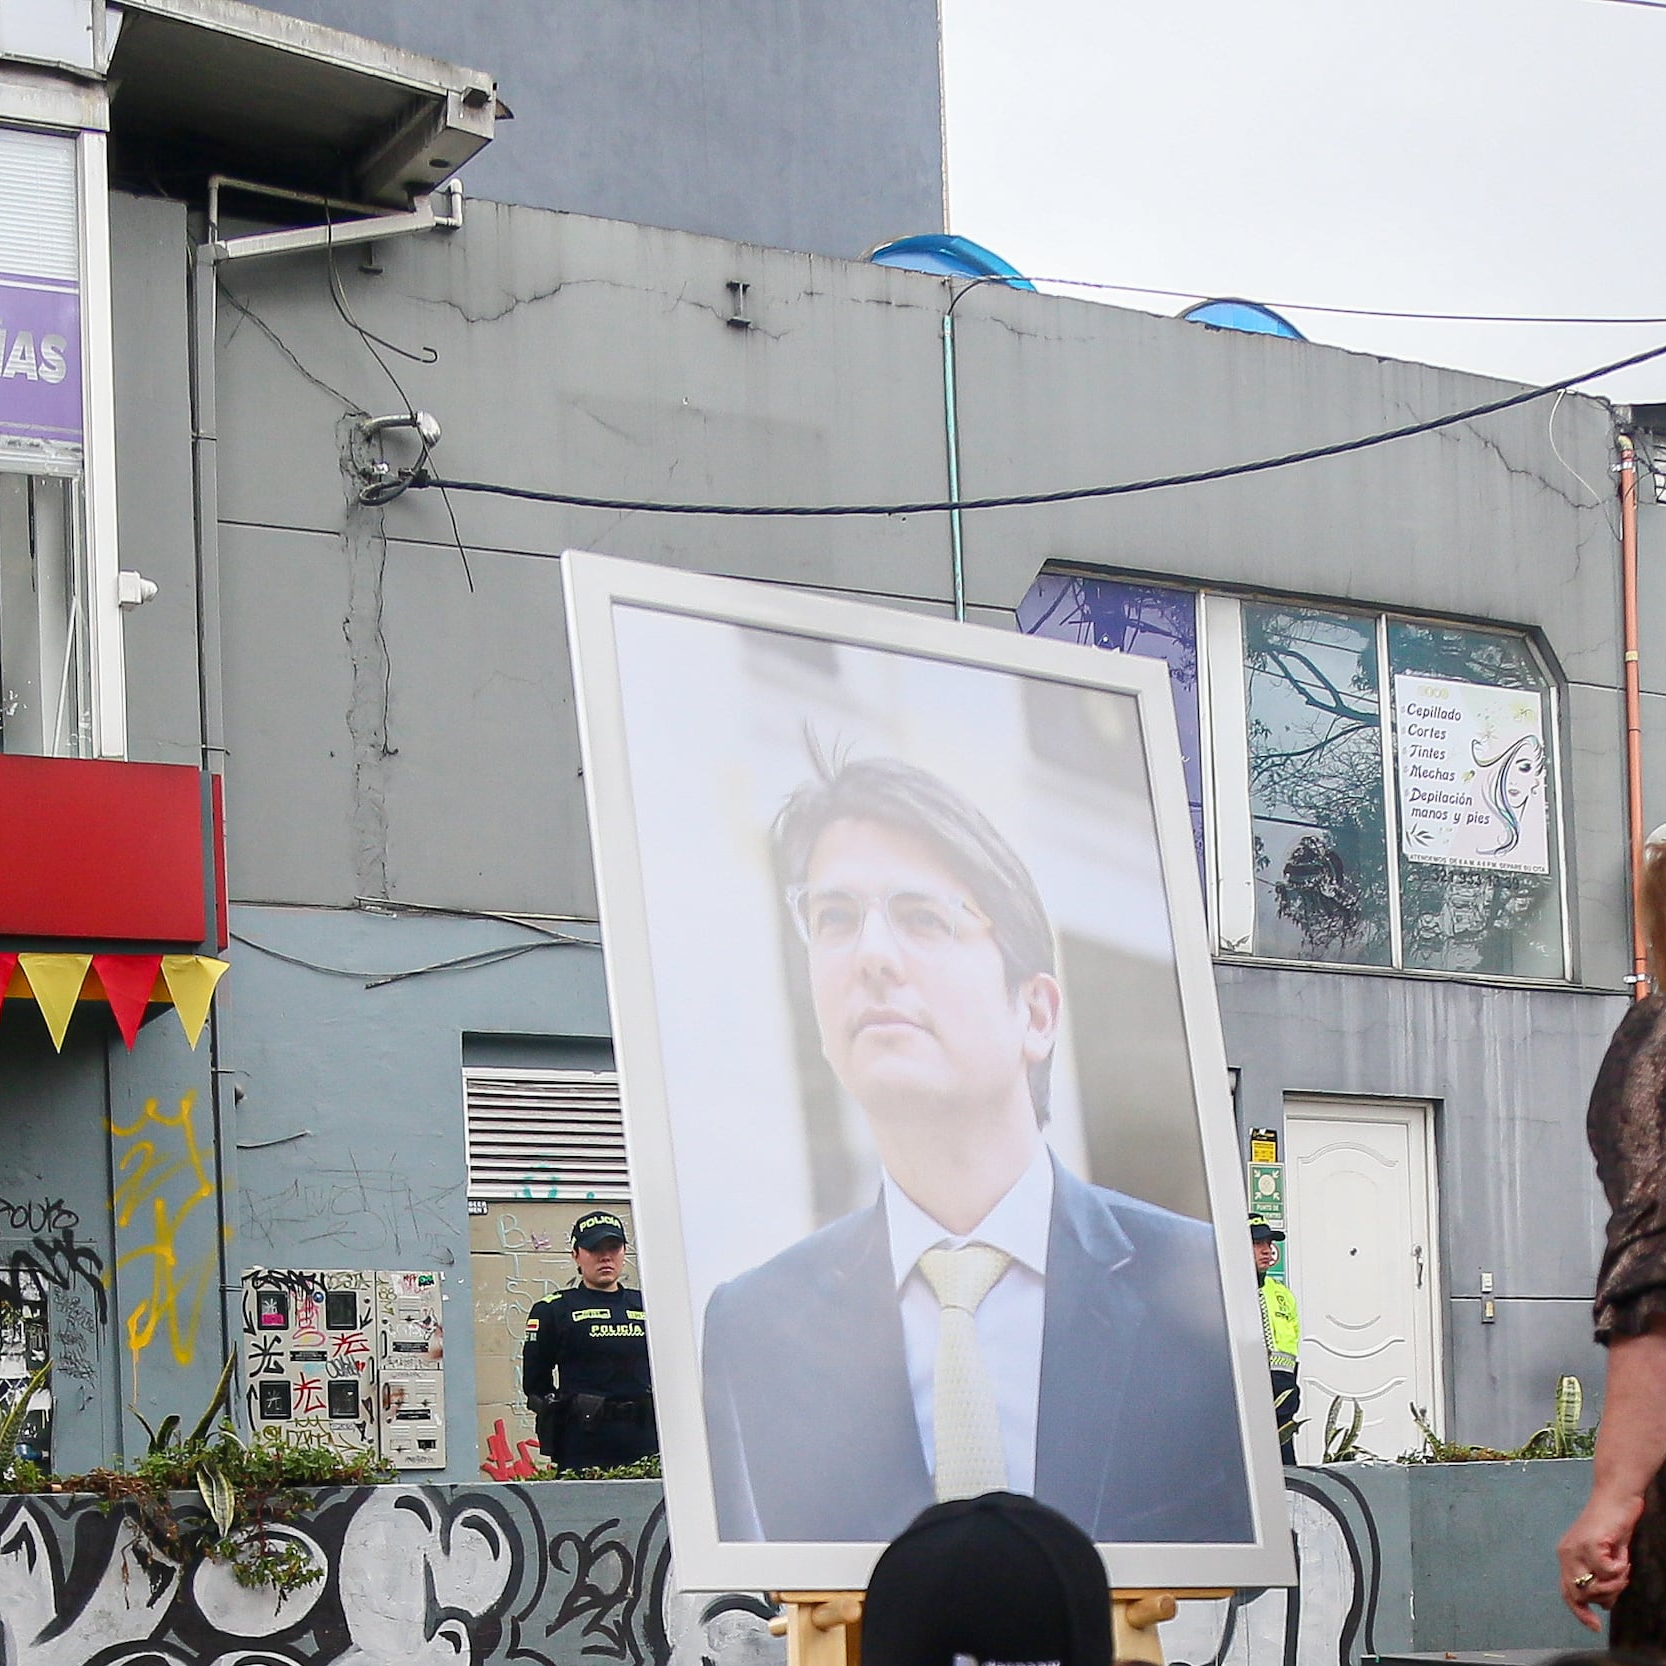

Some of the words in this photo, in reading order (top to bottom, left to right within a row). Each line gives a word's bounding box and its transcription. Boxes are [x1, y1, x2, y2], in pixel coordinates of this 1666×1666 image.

[1407, 703, 1462, 721] Cepillado
[1407, 723, 1447, 740] Cortes
[1409, 744, 1446, 760] Tintes
[1409, 765, 1456, 782] Mechas
[1409, 787, 1473, 806] Depilación
[1411, 806, 1448, 820] manos
[1453, 812, 1462, 824] y
[1466, 811, 1491, 825] pies
[590, 1322, 644, 1334] POLICÍA
